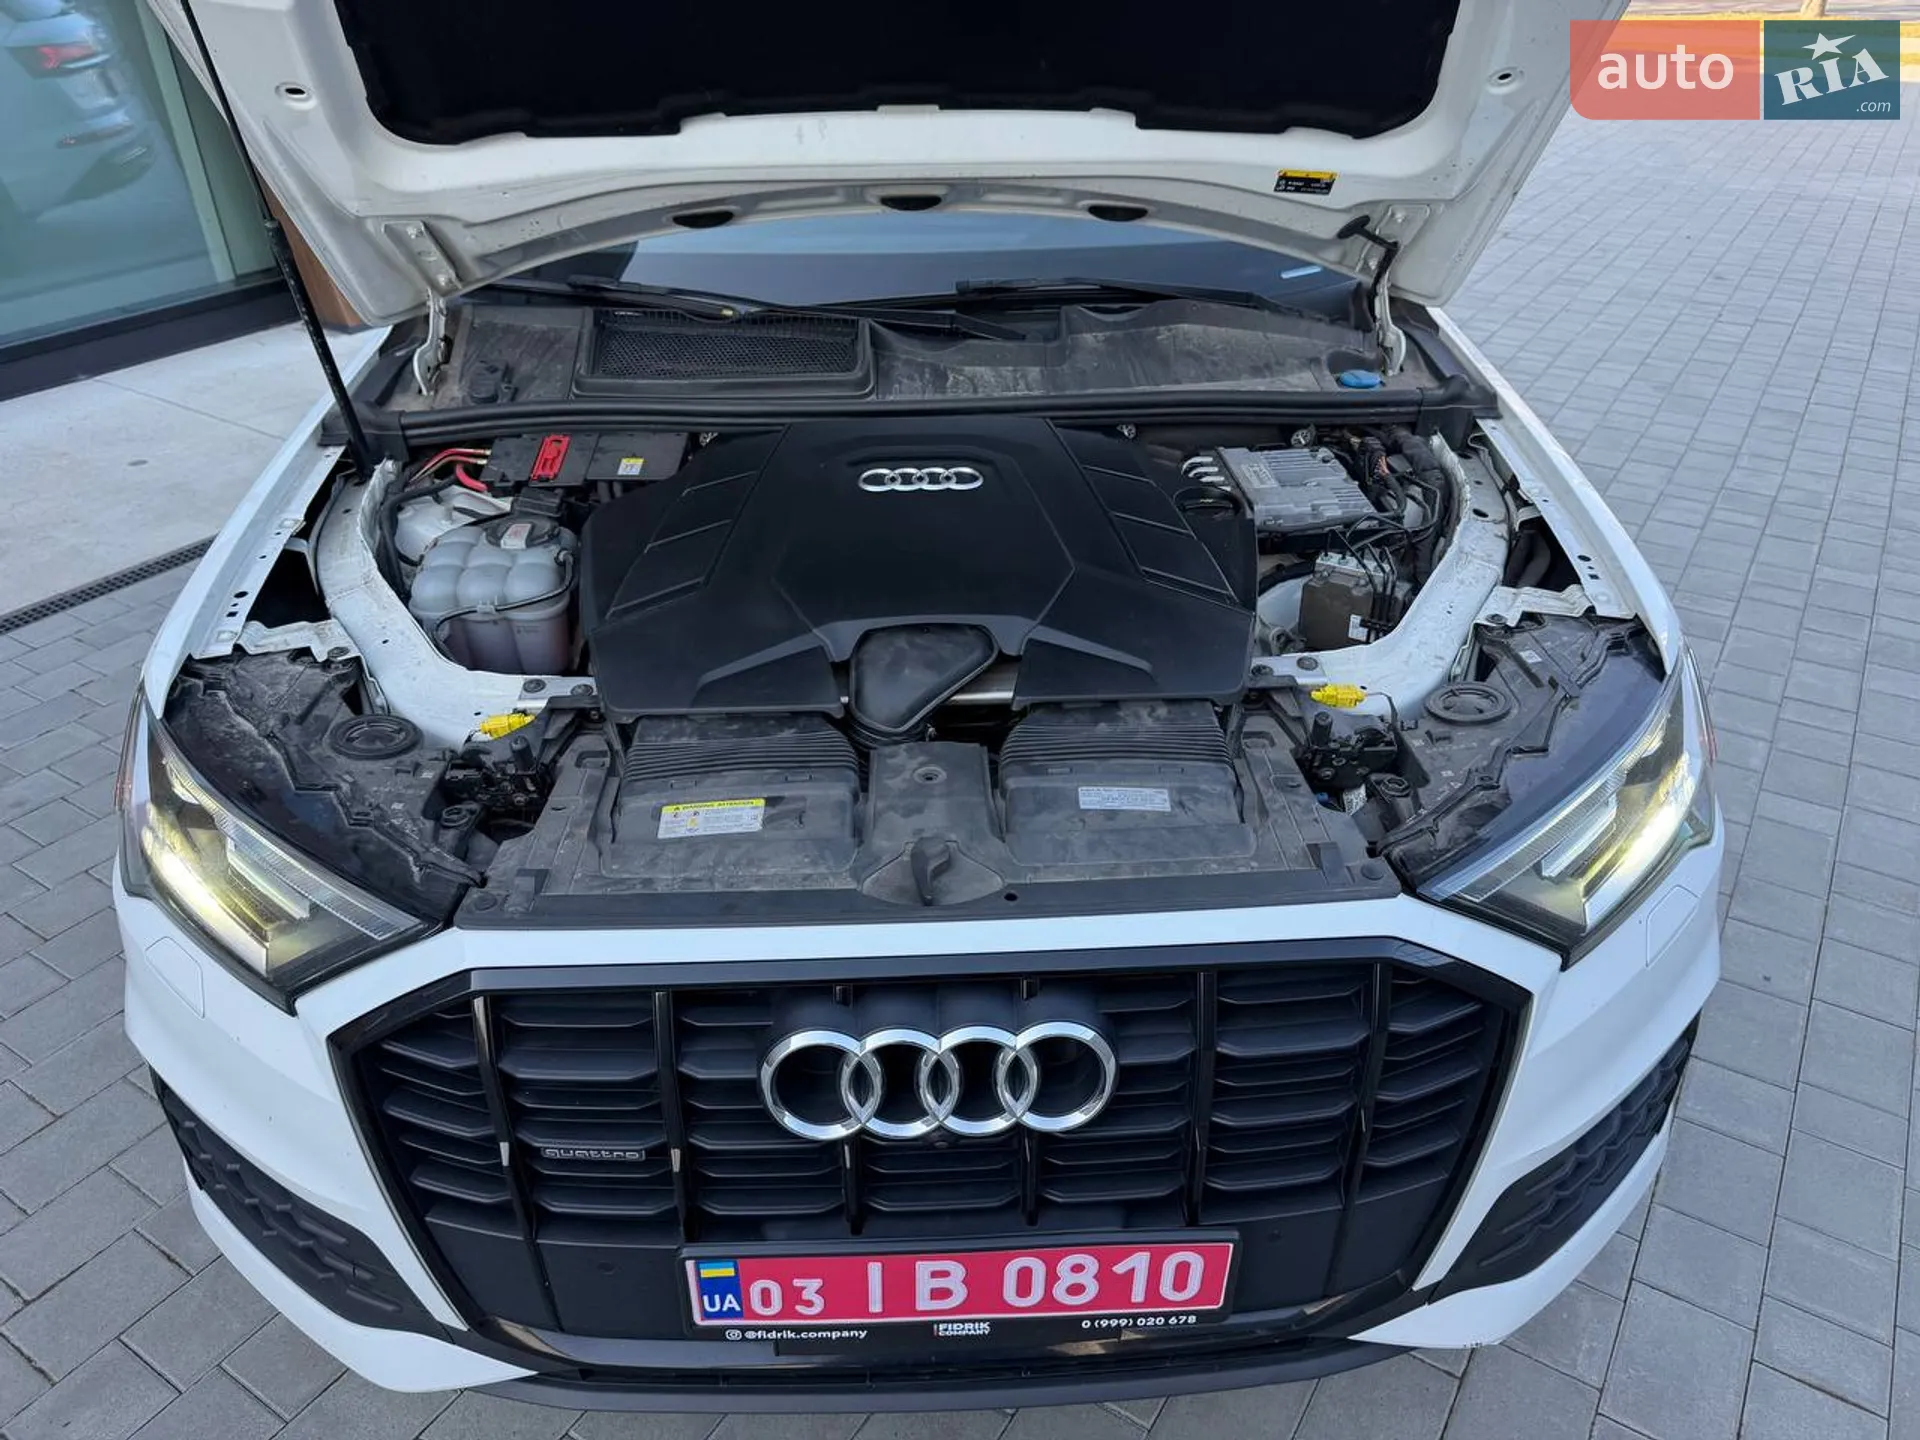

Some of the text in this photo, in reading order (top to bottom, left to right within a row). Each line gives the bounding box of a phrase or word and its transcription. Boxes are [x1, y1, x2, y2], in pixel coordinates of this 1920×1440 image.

[545, 1148, 639, 1159] quattro
[702, 1294, 742, 1313] UA
[750, 1278, 826, 1317] 03
[1002, 1250, 1205, 1308] 0810
[938, 1321, 991, 1331] FIDRIK
[1094, 1317, 1133, 1328] (999)
[1136, 1316, 1164, 1327] 020
[1168, 1315, 1197, 1325] 678
